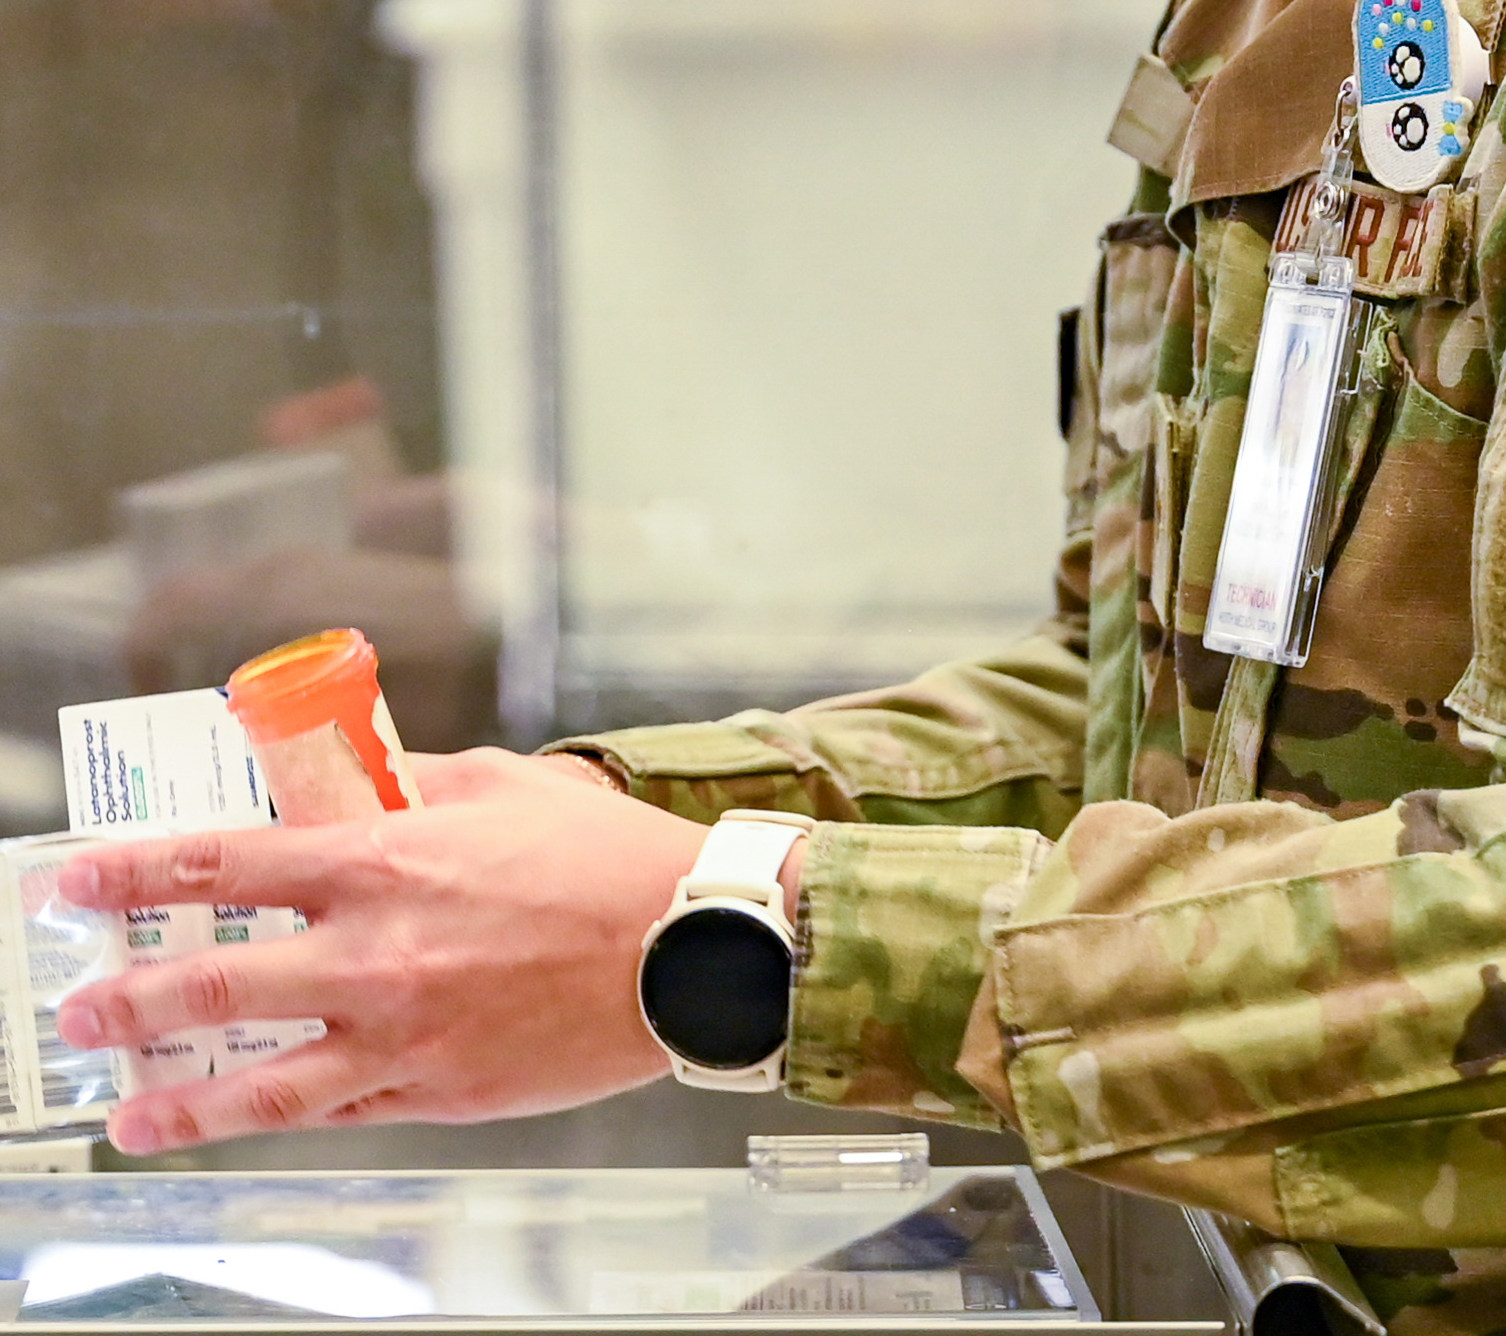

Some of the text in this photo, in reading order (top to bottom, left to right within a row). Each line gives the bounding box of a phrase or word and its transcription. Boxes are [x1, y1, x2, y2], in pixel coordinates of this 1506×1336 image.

[84, 719, 102, 825] Latanoprost
[97, 720, 118, 823] Ophthalmic
[116, 750, 132, 821] Solution
